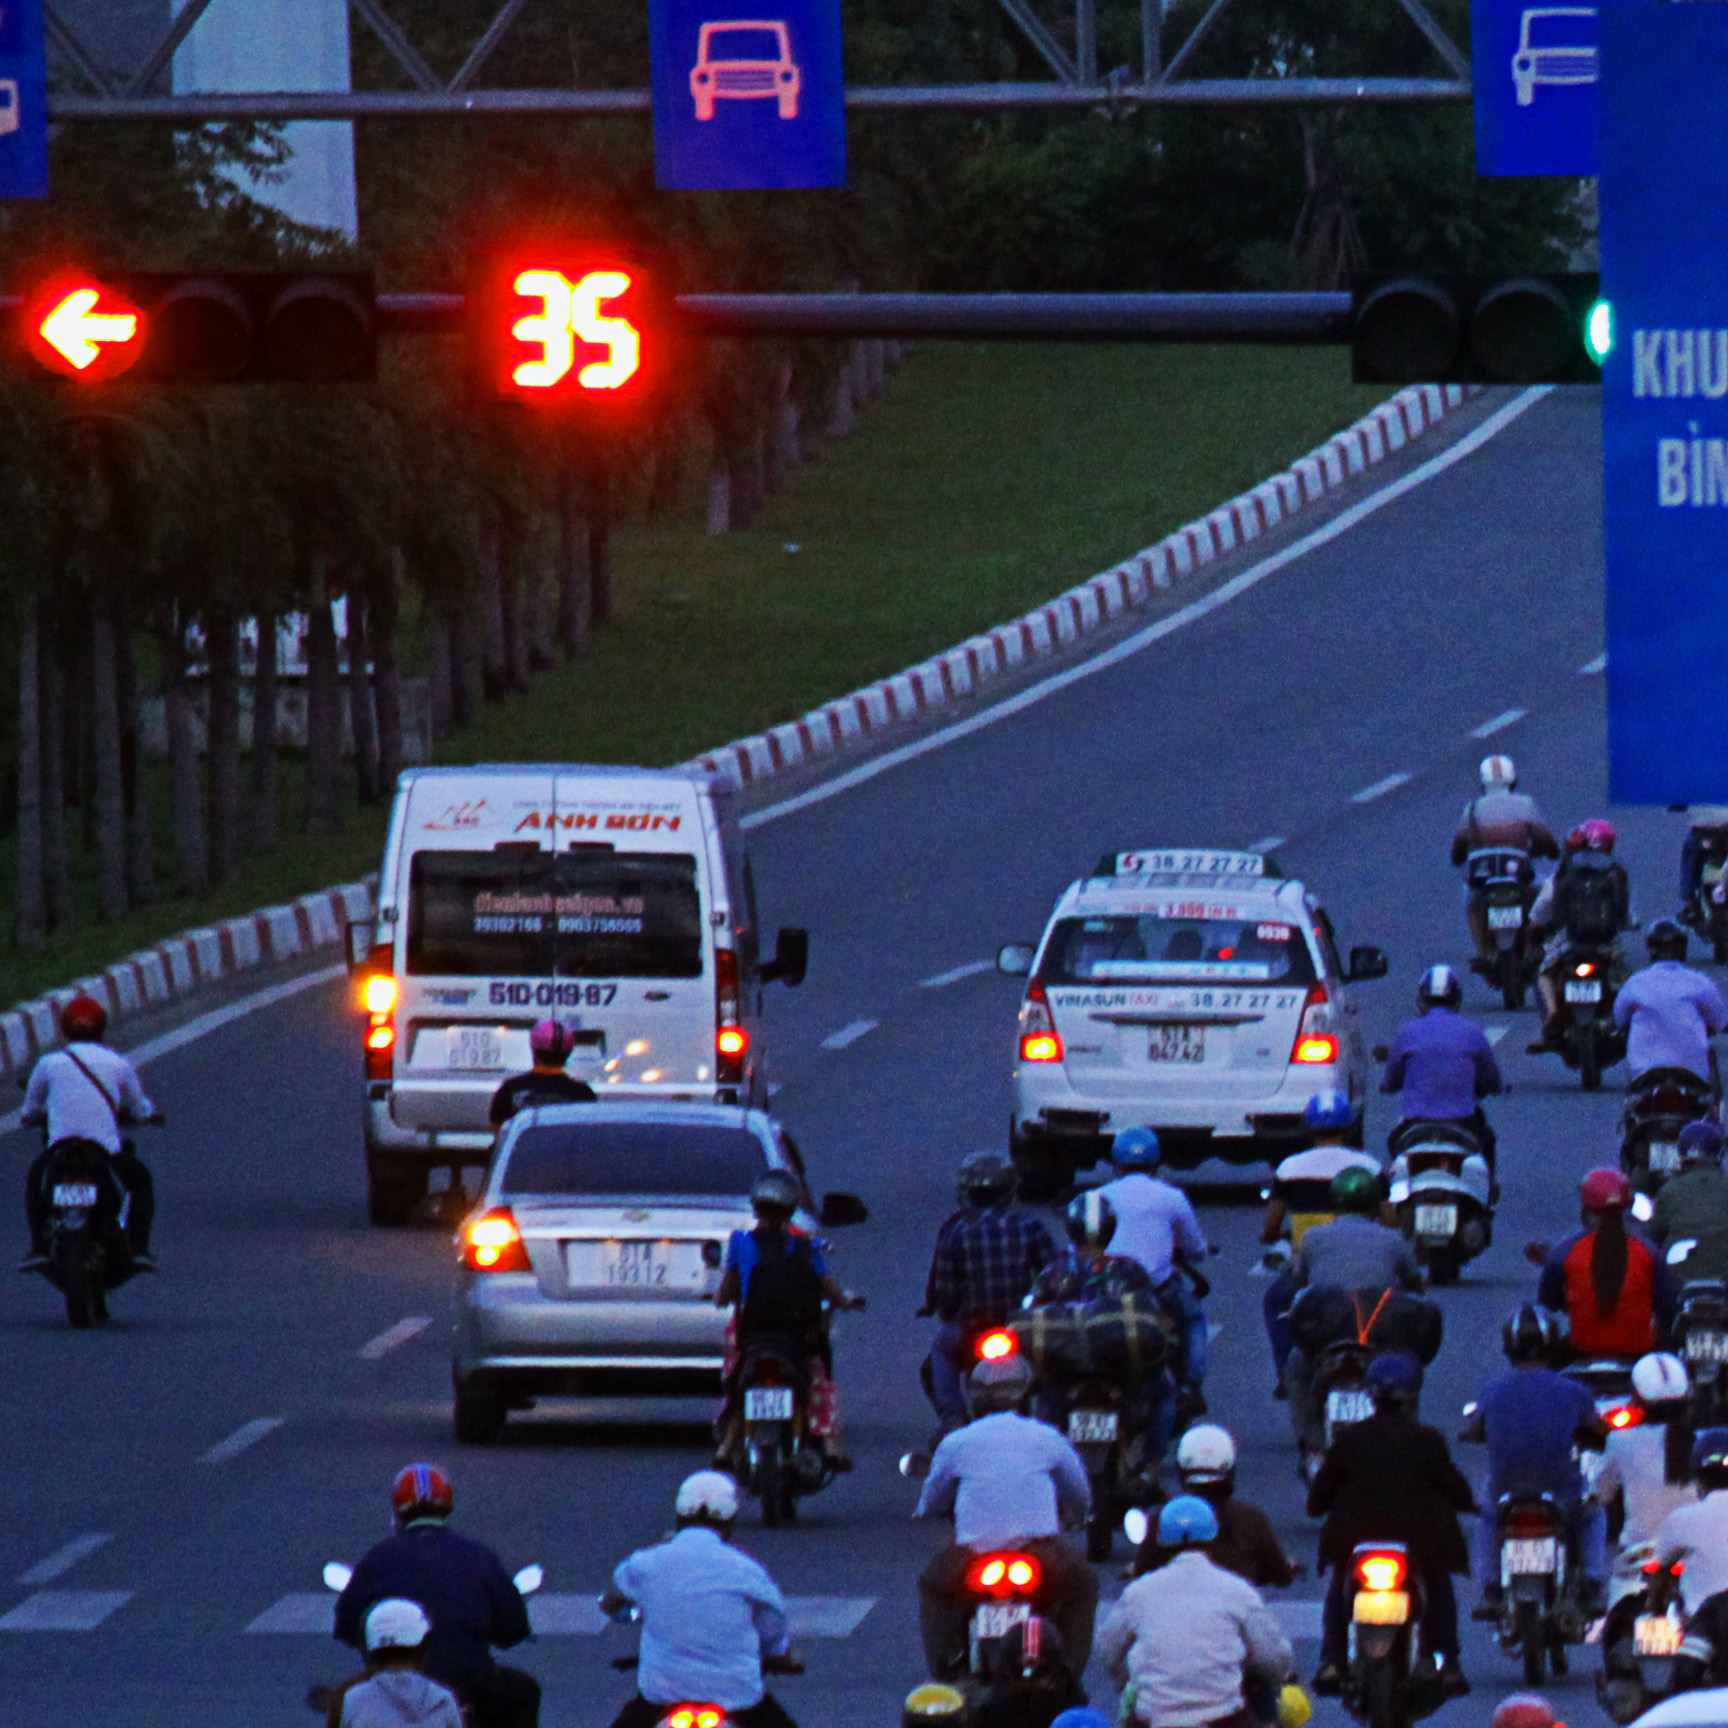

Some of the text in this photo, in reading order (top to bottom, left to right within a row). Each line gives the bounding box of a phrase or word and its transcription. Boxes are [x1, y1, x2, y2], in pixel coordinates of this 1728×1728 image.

[512, 269, 642, 389] 35
[513, 811, 598, 834] ANH
[1055, 994, 1126, 1007] VINASUN
[1129, 993, 1159, 1006] TAXI
